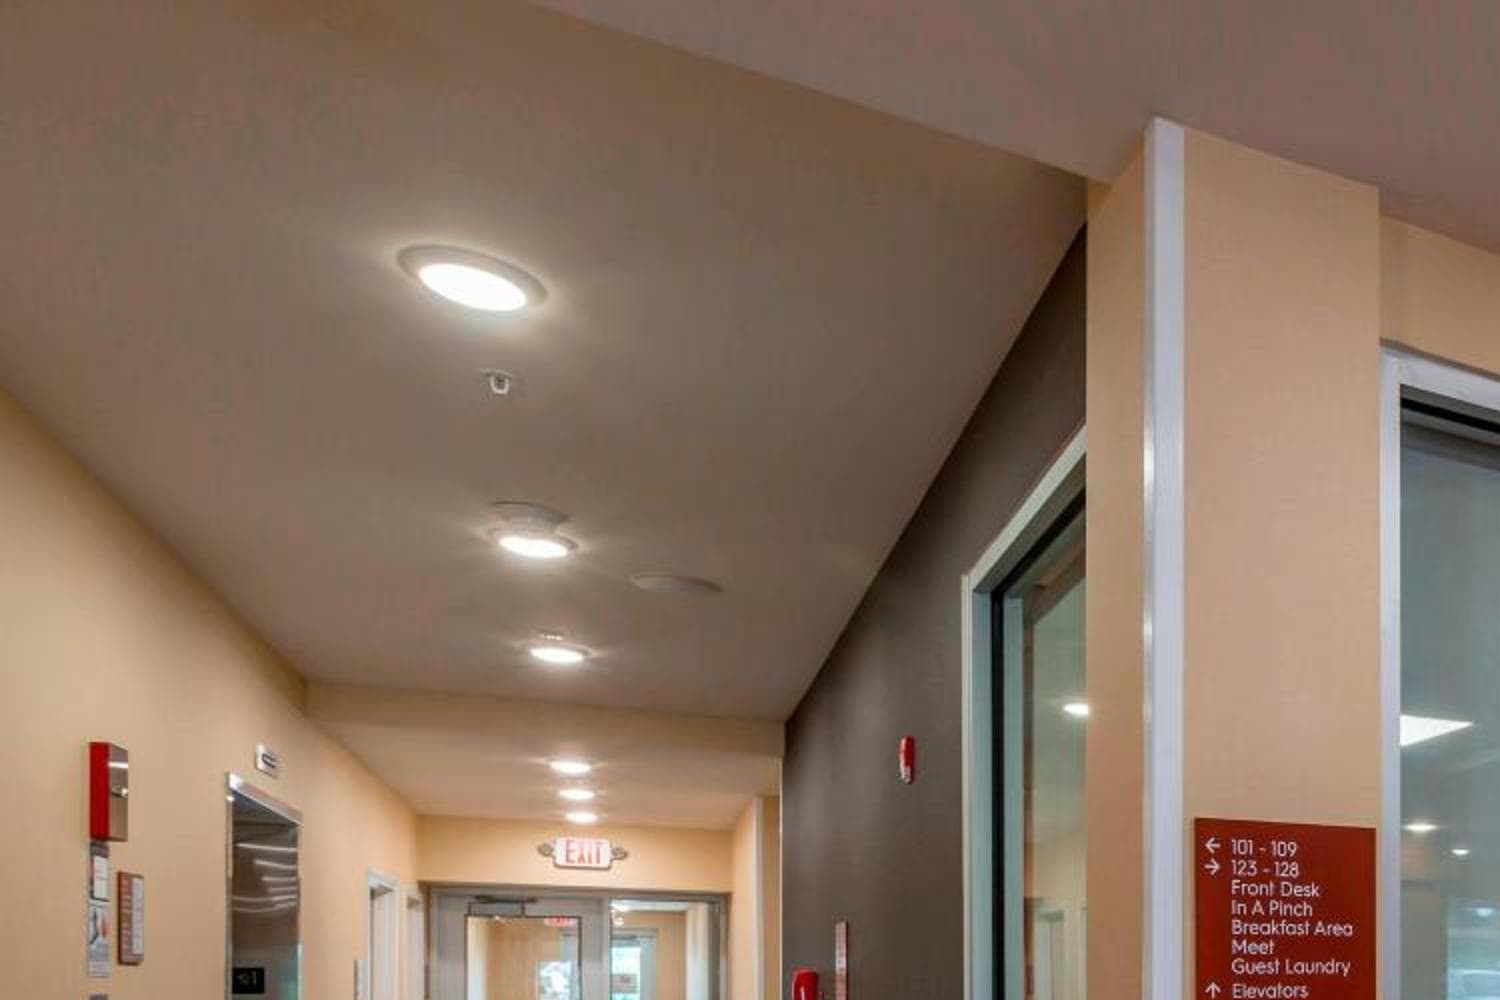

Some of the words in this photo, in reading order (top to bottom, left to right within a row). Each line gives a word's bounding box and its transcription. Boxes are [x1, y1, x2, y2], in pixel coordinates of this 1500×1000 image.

[565, 839, 604, 865] EXIT
[1231, 837, 1254, 855] 101
[1271, 840, 1297, 857] 109
[1231, 859, 1258, 877] 123
[1274, 861, 1300, 878] 128
[1231, 879, 1275, 897] Front
[1280, 881, 1321, 897] Desk
[1231, 899, 1247, 915] In
[1251, 899, 1265, 915] A
[1269, 899, 1313, 917] Pinch
[1231, 919, 1310, 936] Breakfast
[1313, 921, 1354, 937] Area
[1231, 939, 1275, 955] Meet
[1231, 958, 1280, 976] Guest
[1285, 958, 1351, 977] Laundry
[1232, 983, 1309, 999] Elevators
